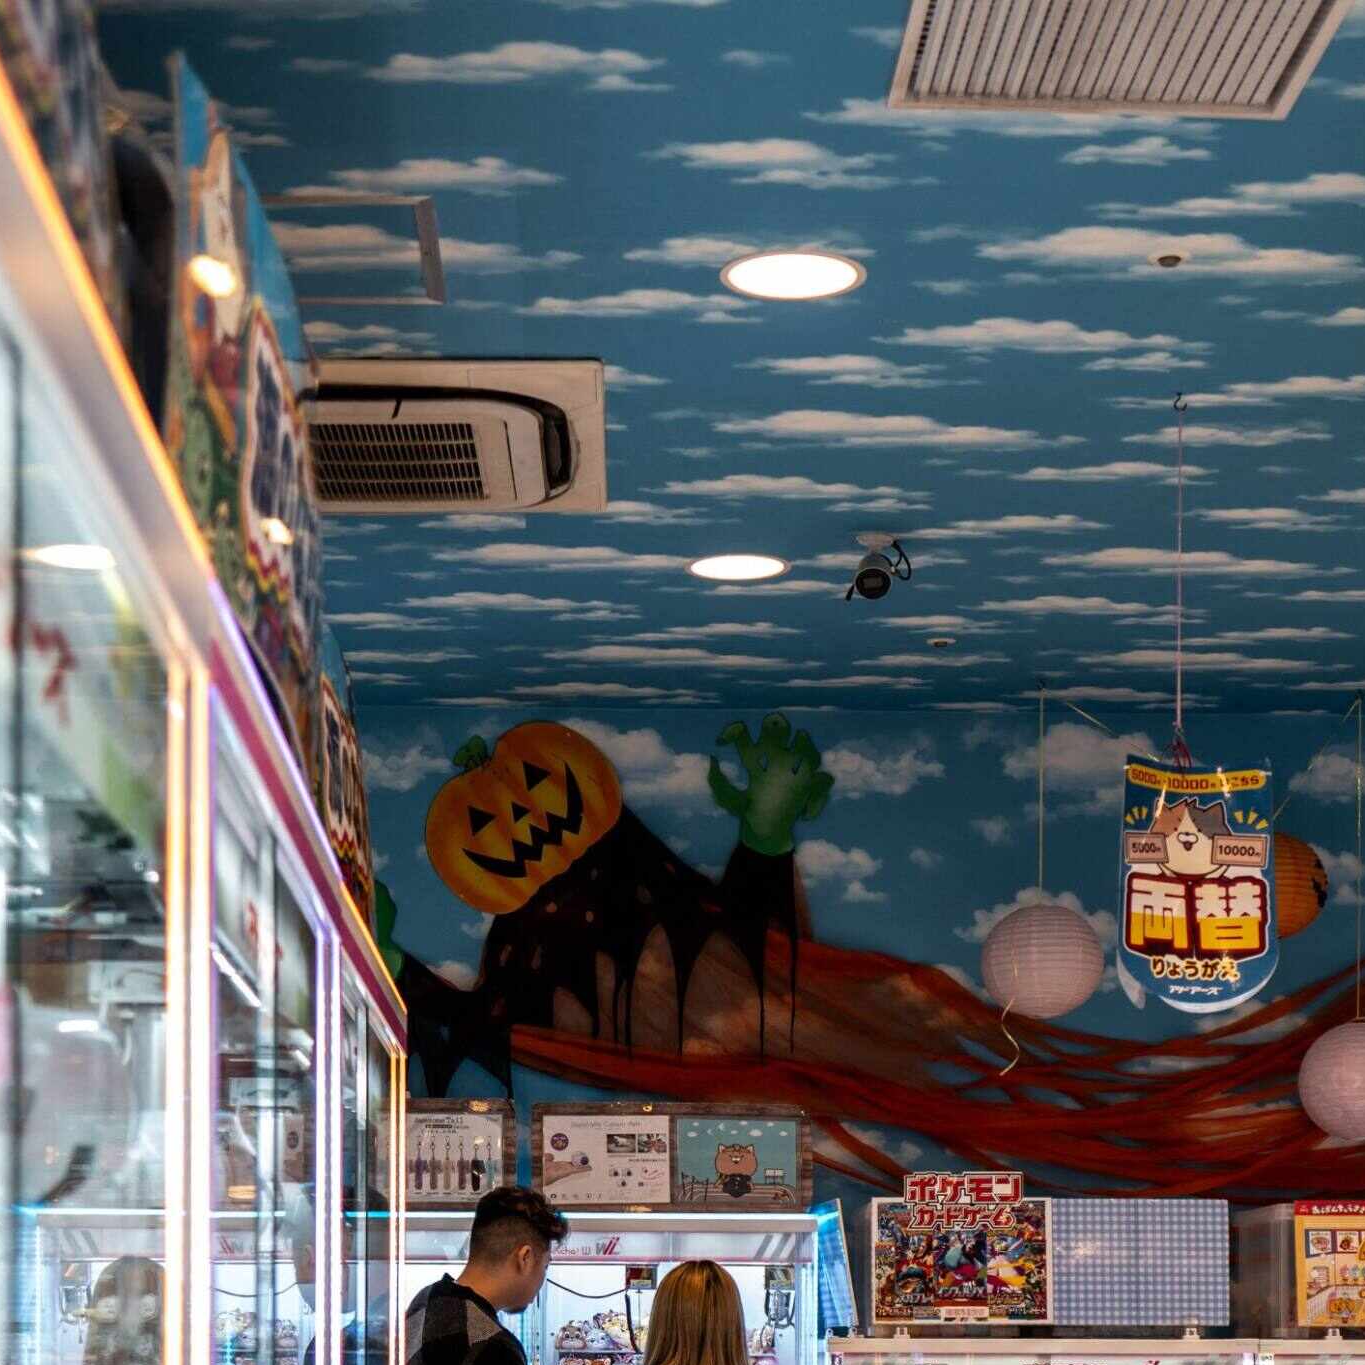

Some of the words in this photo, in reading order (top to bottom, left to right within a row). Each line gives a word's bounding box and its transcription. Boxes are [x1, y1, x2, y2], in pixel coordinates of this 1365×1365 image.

[1130, 878, 1263, 950] 両替
[1151, 955, 1241, 981] りょうがえ
[908, 1175, 1021, 1201] ポケモン
[915, 1206, 1013, 1226] カードゲーム
